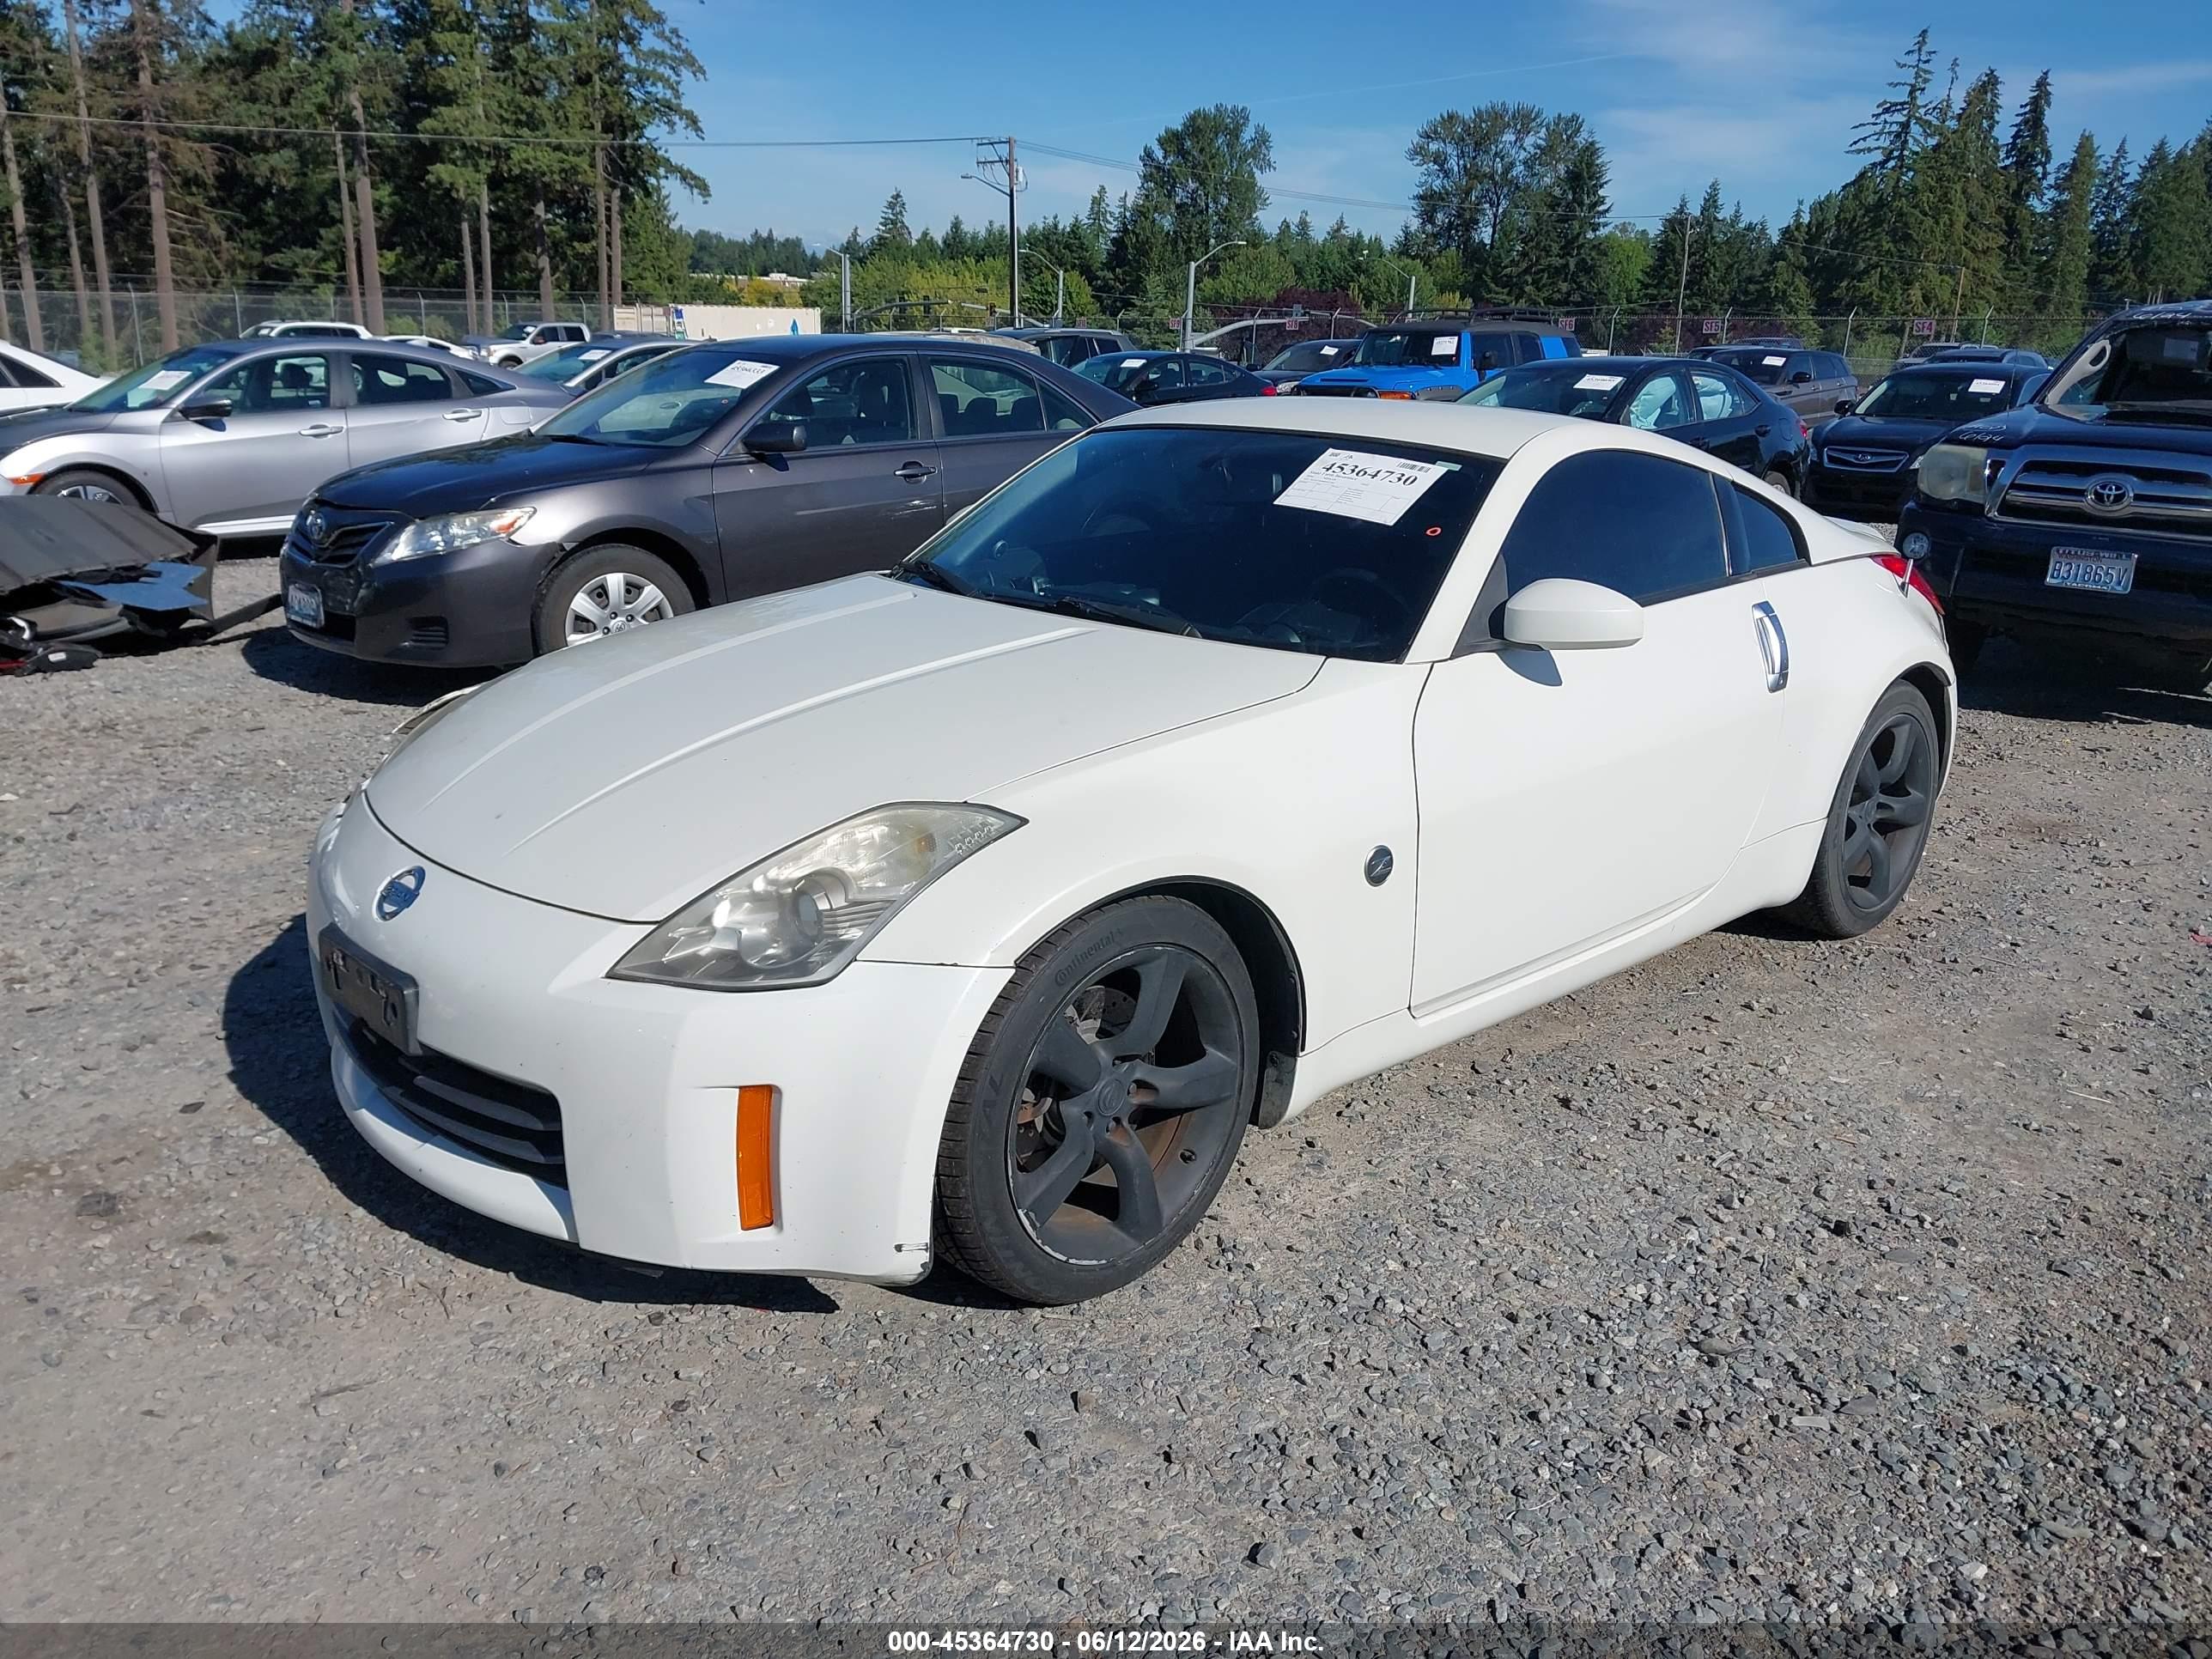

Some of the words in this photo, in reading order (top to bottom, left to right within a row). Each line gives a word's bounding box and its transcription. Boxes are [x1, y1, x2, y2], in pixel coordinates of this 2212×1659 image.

[1559, 319, 1574, 331] SF6
[1705, 321, 1720, 331] SF5
[1915, 321, 1933, 333] SF4
[1322, 461, 1419, 487] 45364730
[2051, 561, 2128, 586] B31865V
[1054, 930, 1115, 987] Continental
